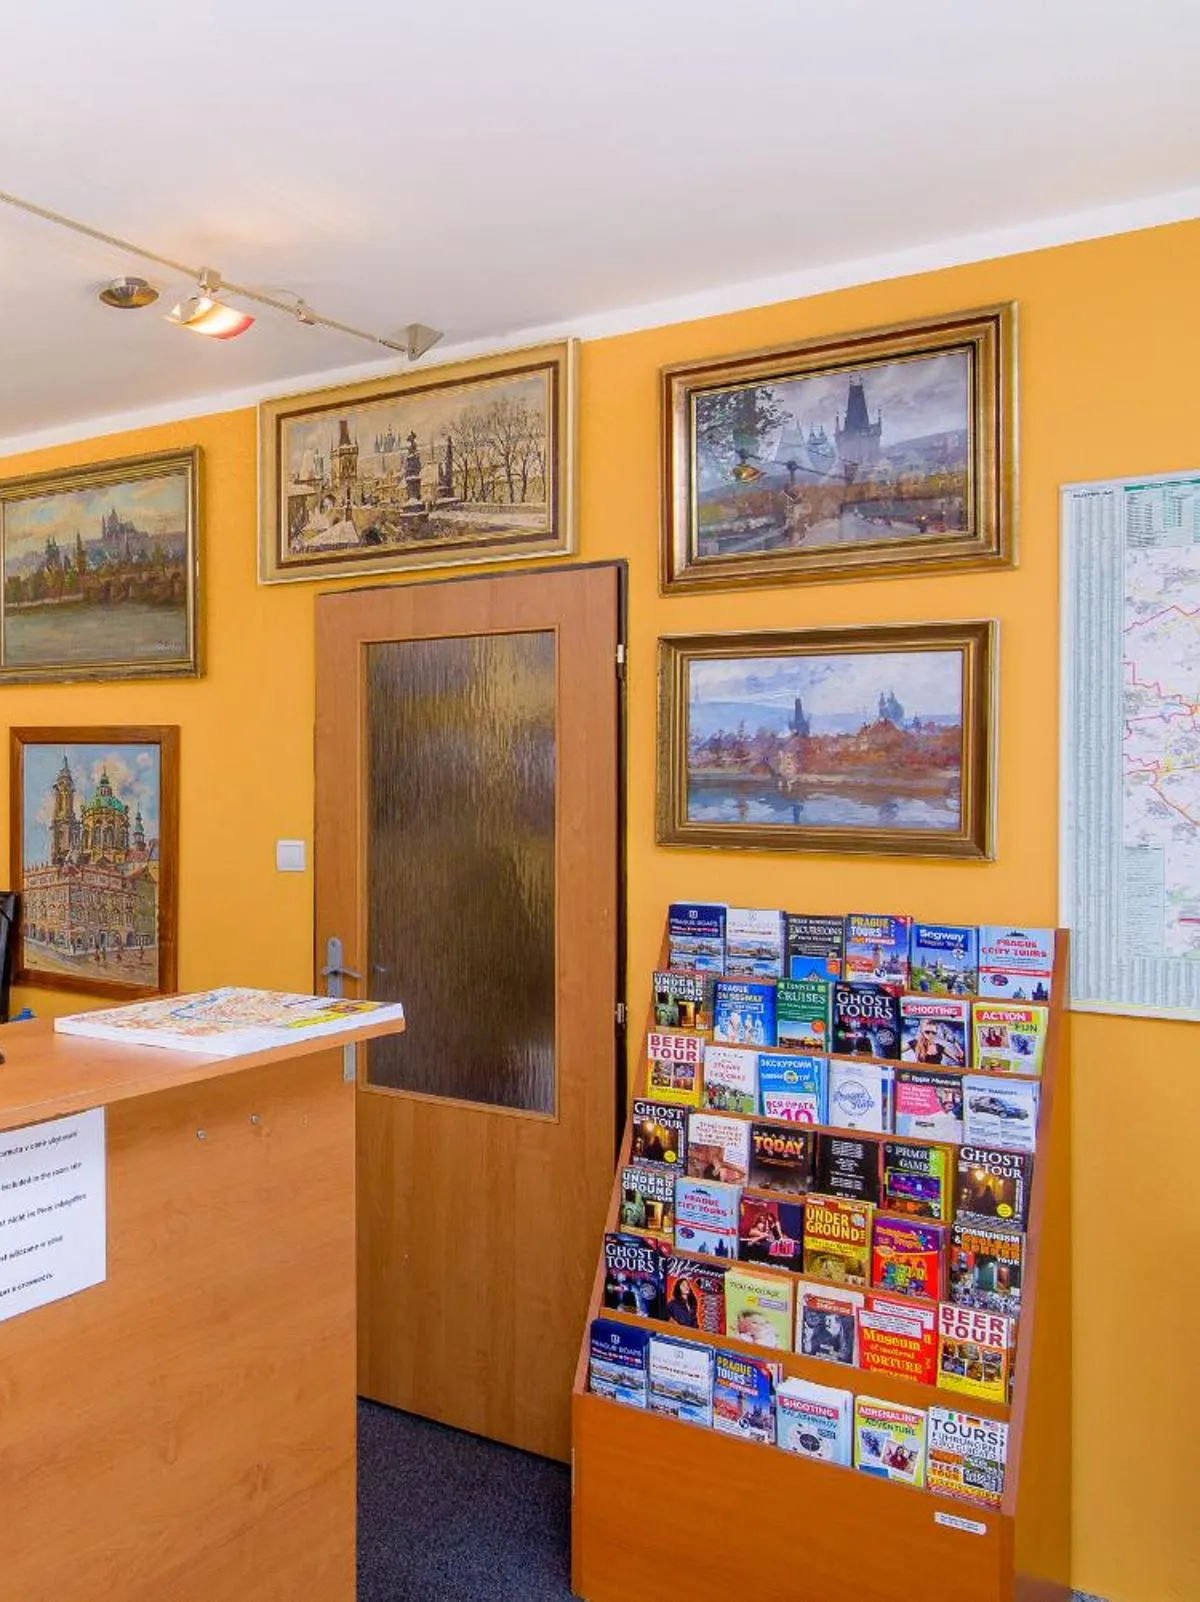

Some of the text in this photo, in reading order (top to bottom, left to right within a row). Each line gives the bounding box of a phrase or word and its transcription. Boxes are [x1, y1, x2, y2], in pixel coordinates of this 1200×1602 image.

[836, 992, 893, 1007] GHOST
[836, 1003, 893, 1020] TOURS
[982, 1011, 1027, 1021] ACTION
[650, 1034, 697, 1050] BEER
[649, 1048, 697, 1062] TOUR
[634, 1101, 684, 1119] GHOST
[653, 1118, 684, 1131] TOUR
[754, 1135, 804, 1155] TODAY
[960, 1146, 1024, 1167] GHOST
[983, 1163, 1023, 1179] TOUR
[806, 1204, 849, 1226] UNDER
[806, 1221, 860, 1241] GROUND
[606, 1243, 653, 1261] GHOST
[606, 1255, 654, 1273] TOURS
[941, 1304, 1004, 1332] BEER
[862, 1328, 921, 1351] Museum
[940, 1321, 1004, 1347] TOUR
[716, 1356, 752, 1377] PRAGUE
[863, 1351, 923, 1375] TORTURE
[782, 1397, 835, 1417] SHOOTING
[931, 1418, 998, 1446] TOURS
